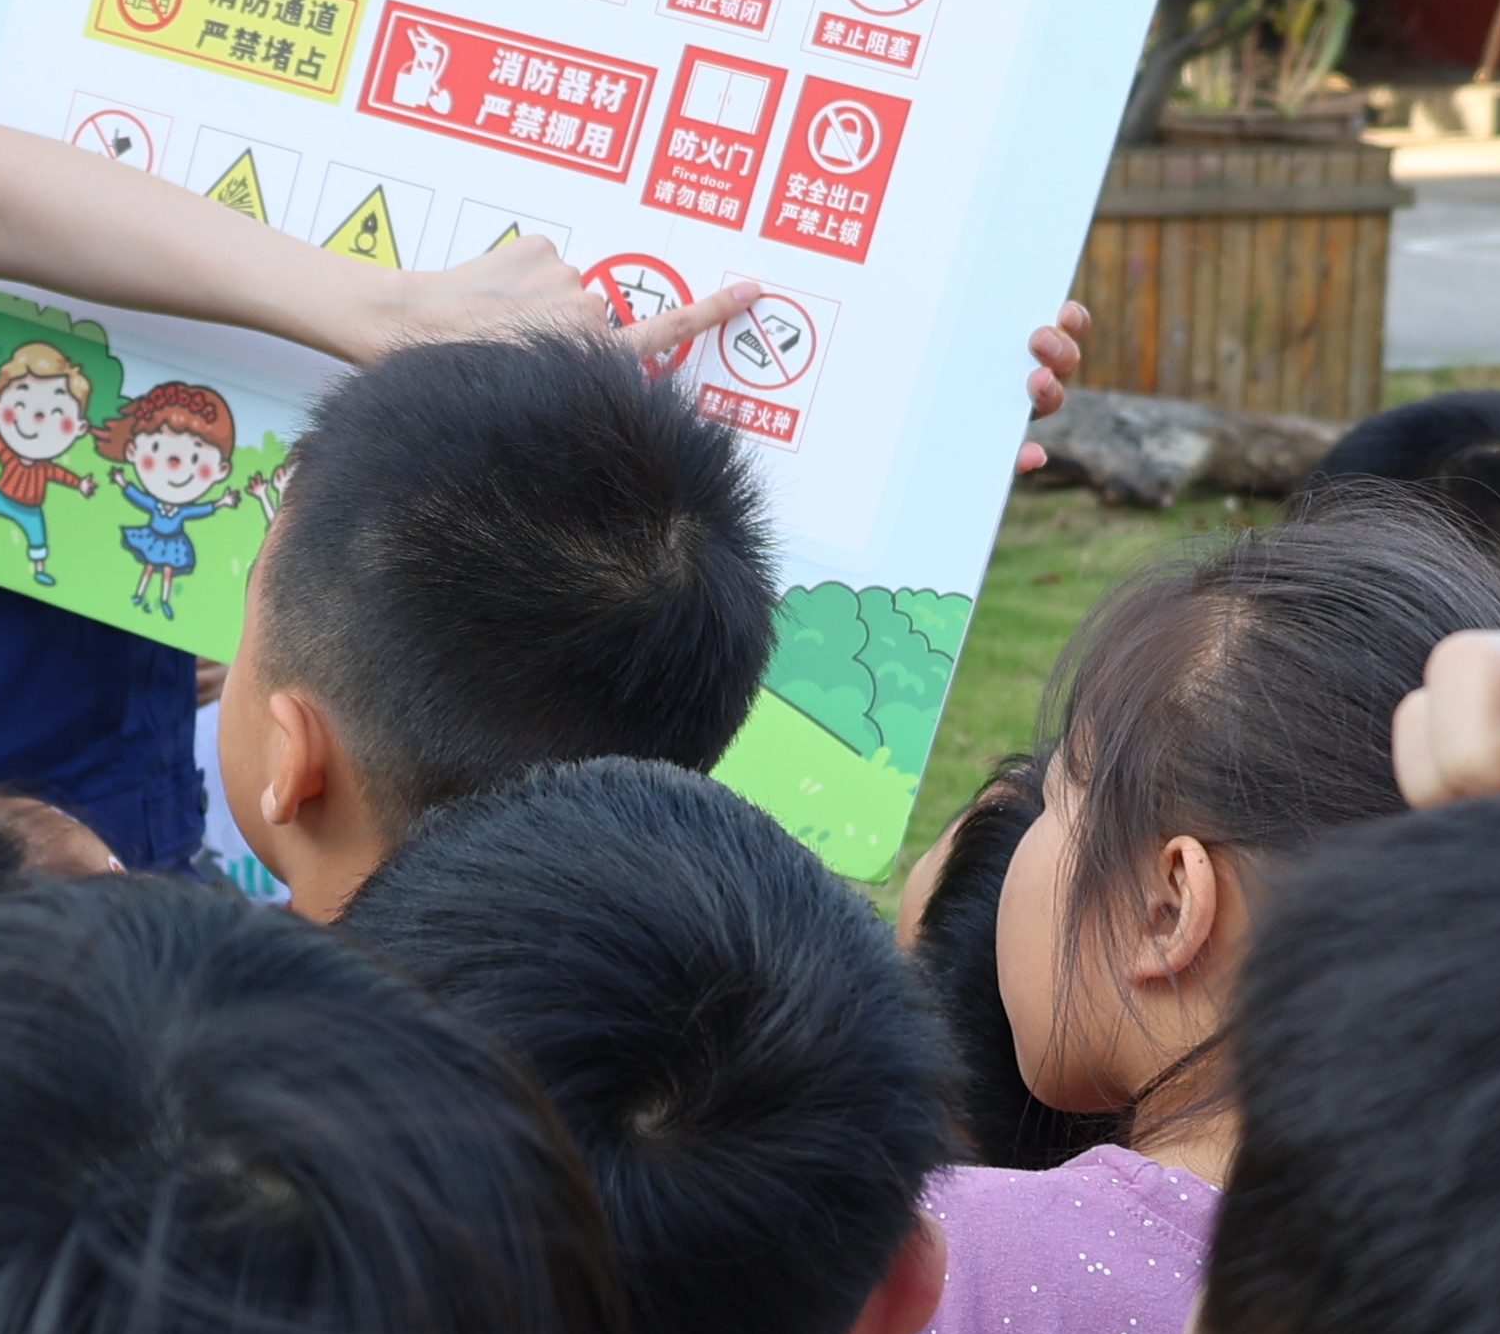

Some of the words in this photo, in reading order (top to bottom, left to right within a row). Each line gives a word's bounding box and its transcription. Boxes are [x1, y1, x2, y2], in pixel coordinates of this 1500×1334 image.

[195, 18, 328, 82] 严禁堵占
[821, 19, 914, 62] 禁止阻塞
[487, 47, 627, 113] 消防器材
[475, 92, 615, 160] 严禁挪用
[667, 127, 755, 177] 防火门
[653, 179, 741, 221] 请勿锁闭
[671, 165, 698, 183] Fire
[700, 173, 732, 192] door
[785, 173, 870, 214] 安全出口
[775, 202, 863, 247] 严禁上锁
